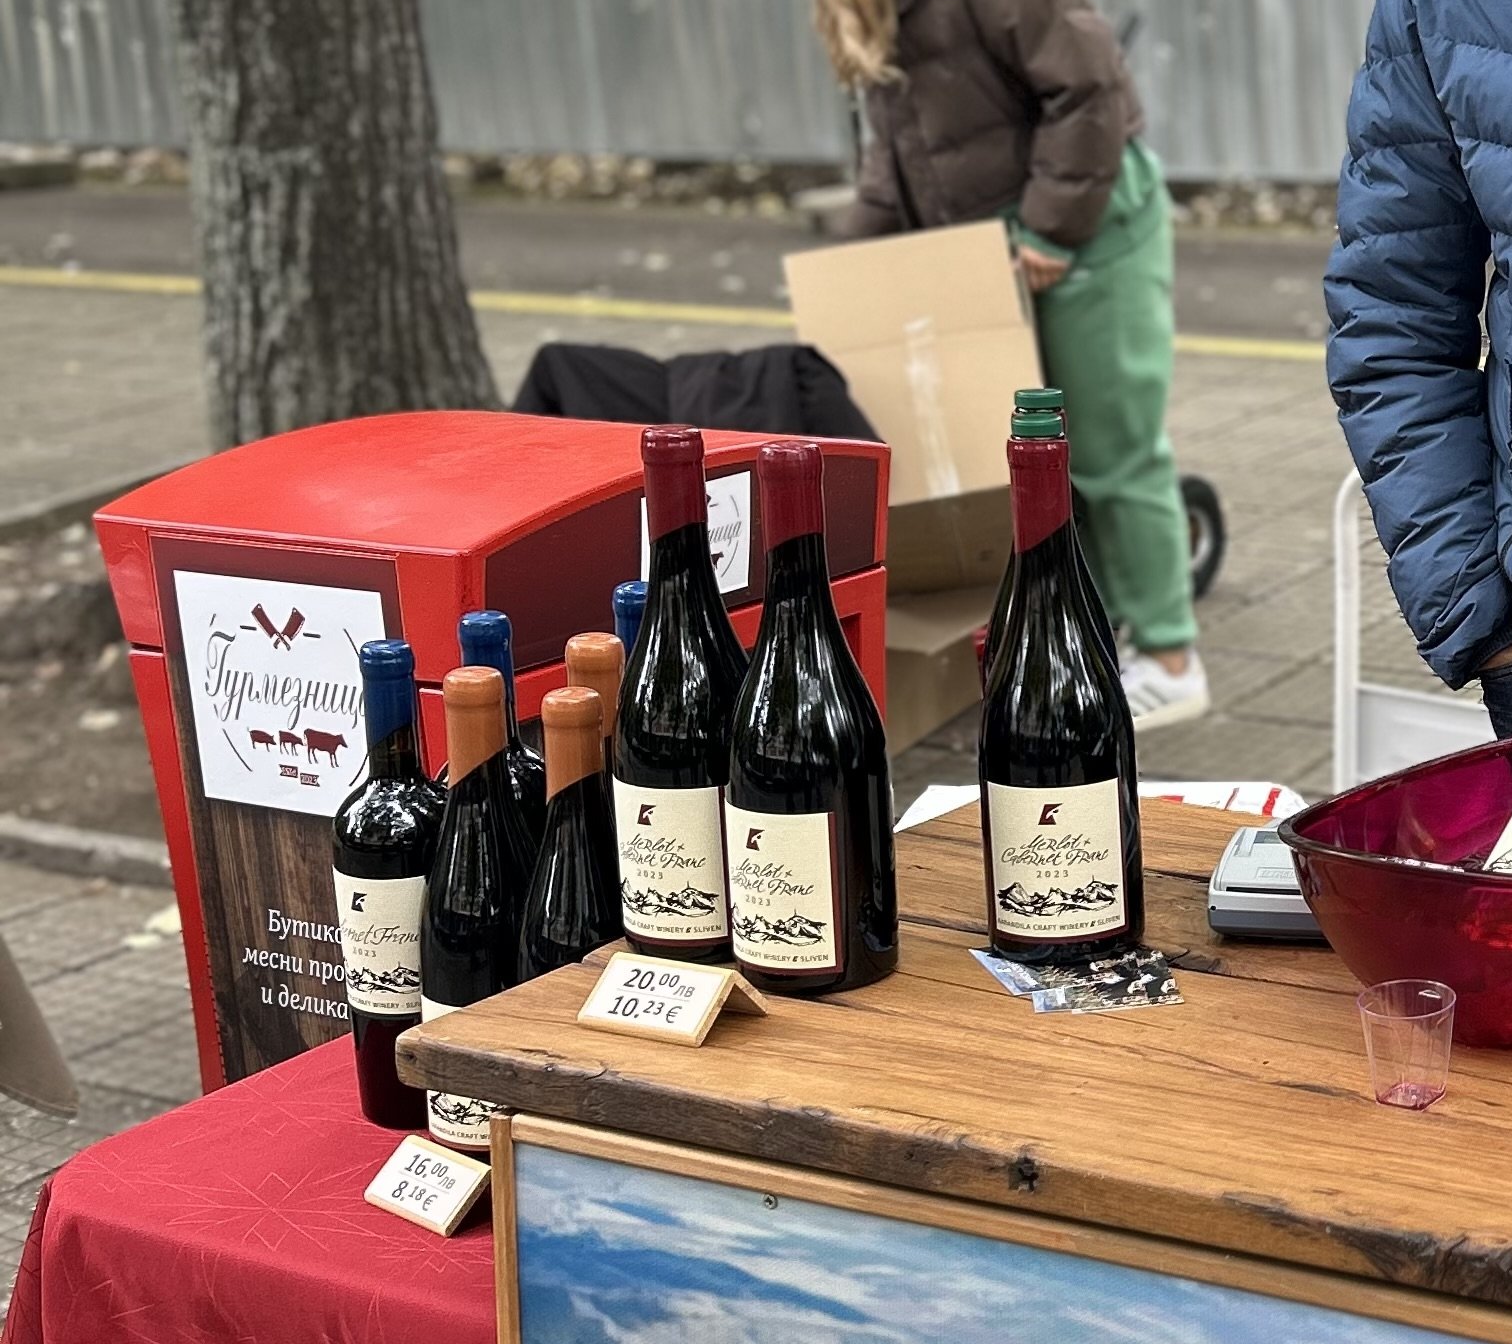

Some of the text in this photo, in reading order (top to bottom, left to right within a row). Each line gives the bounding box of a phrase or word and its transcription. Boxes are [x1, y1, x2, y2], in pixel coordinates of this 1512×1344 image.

[1036, 869, 1069, 879] 2023
[242, 947, 304, 975] месни
[261, 985, 273, 1005] и
